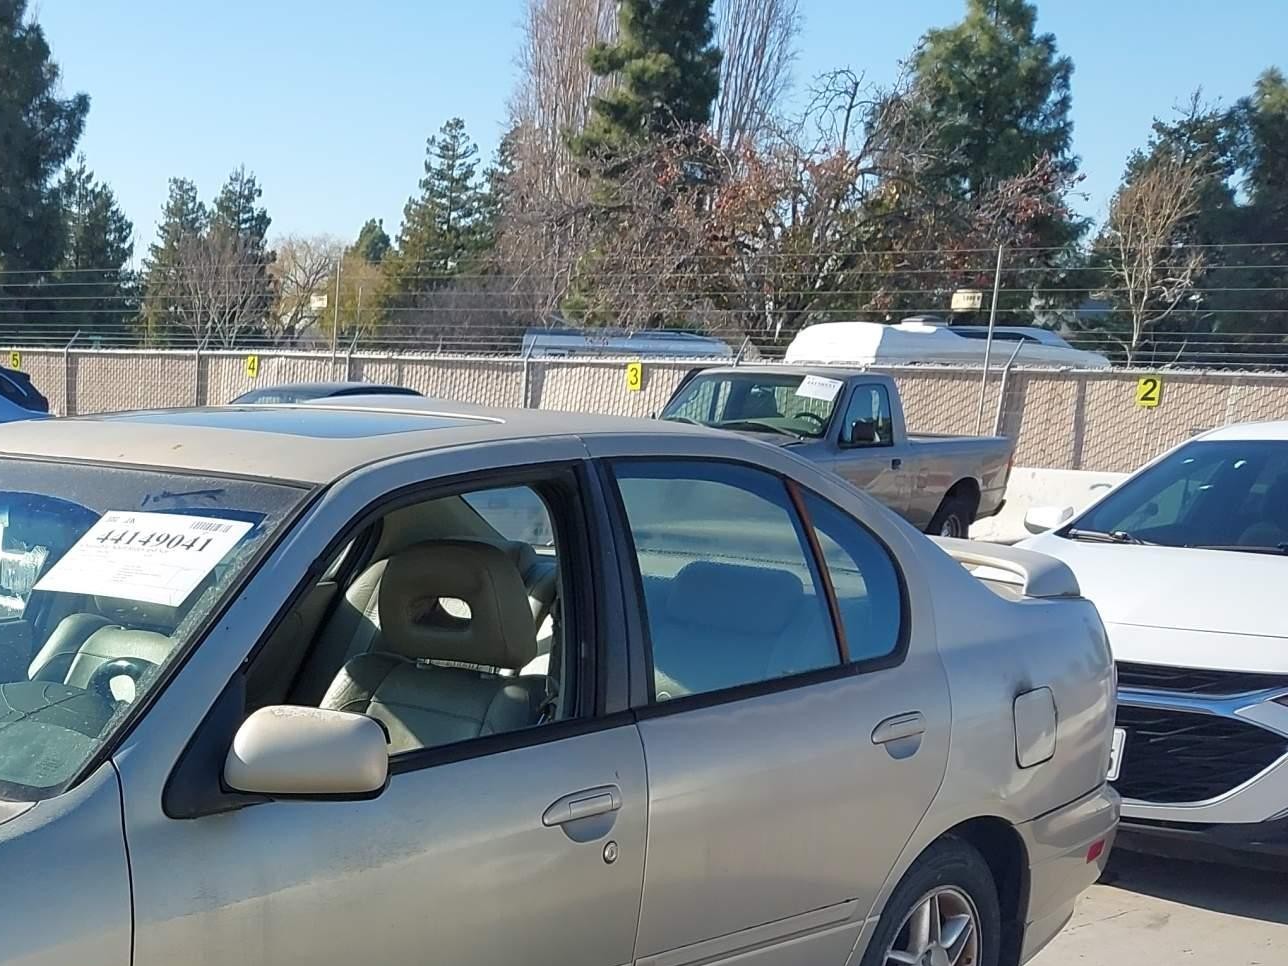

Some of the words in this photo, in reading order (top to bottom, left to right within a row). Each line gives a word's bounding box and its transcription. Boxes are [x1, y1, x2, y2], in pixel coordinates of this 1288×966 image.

[11, 353, 19, 368] 5
[247, 358, 256, 374] 4
[629, 367, 639, 386] 3
[1140, 378, 1158, 401] 2
[96, 529, 214, 552] 44149041
